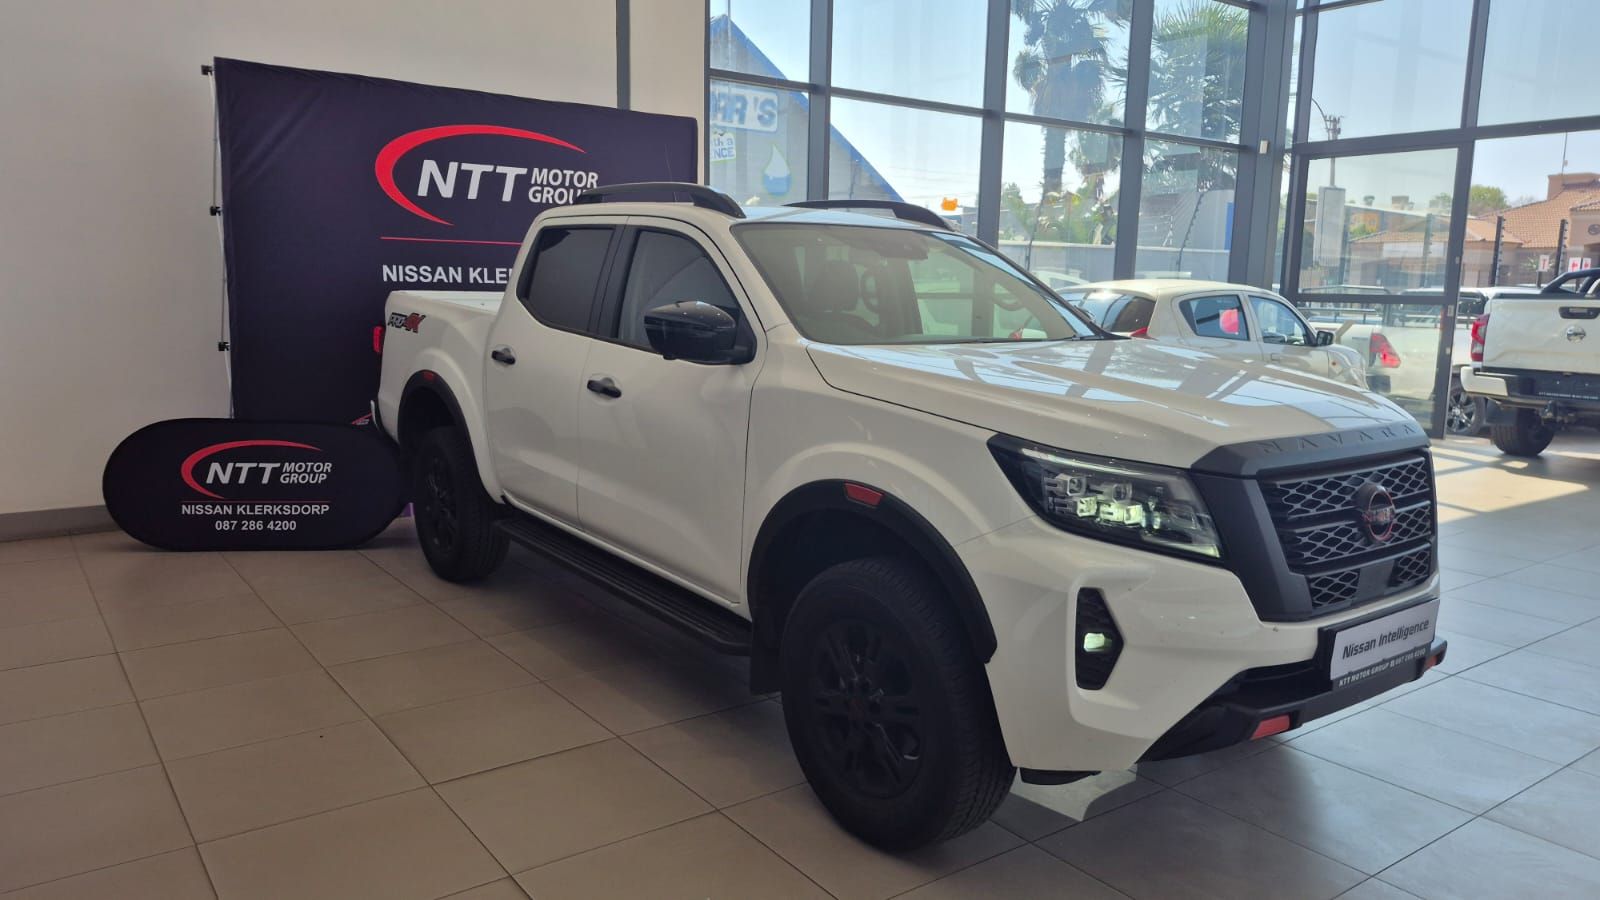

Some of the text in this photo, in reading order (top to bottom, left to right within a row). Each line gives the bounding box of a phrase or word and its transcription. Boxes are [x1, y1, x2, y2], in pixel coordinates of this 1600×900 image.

[417, 159, 527, 202] NTT
[531, 168, 599, 188] MOTOR
[528, 186, 587, 205] GROU
[382, 264, 513, 284] NISSAN KLE
[1258, 424, 1416, 453] NAVARA
[206, 462, 280, 484] NTT
[282, 462, 332, 473] MOTOR
[280, 473, 327, 484] GROUP
[181, 504, 330, 515] NISSAN KLERKSDORP
[215, 520, 297, 531] 087 286 4200
[1343, 620, 1429, 660] Nissan Intelligence
[1339, 676, 1351, 687] NTT
[1351, 669, 1370, 682] MOTOR
[1371, 662, 1389, 675] GROUP
